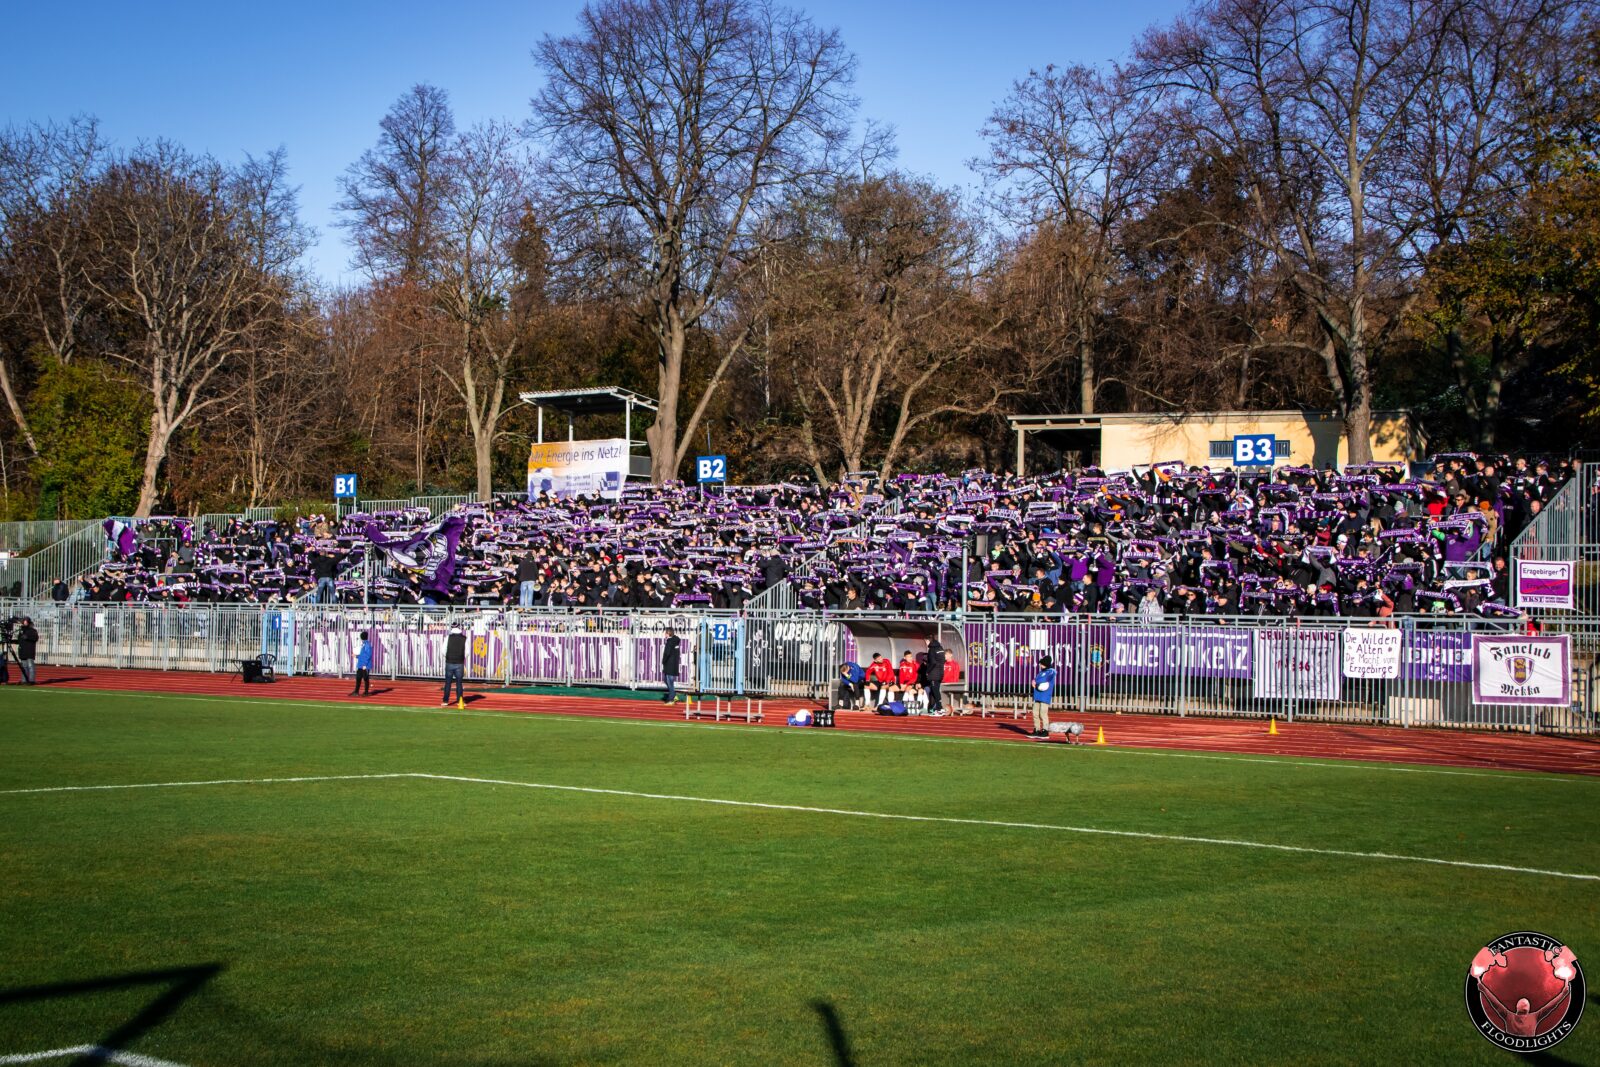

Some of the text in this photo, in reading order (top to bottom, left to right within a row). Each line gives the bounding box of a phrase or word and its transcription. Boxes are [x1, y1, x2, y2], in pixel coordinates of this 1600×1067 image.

[546, 449, 580, 466] Energie
[581, 447, 595, 461] ins
[597, 445, 622, 459] Netz!
[1236, 438, 1273, 462] B3
[699, 459, 724, 479] B2
[336, 477, 354, 494] B1
[1522, 567, 1559, 576] Erzgebirger
[718, 625, 725, 639] 2
[1345, 632, 1397, 645] Die Wilden
[1167, 640, 1248, 670] onkelz
[1356, 644, 1383, 655] Alten
[1490, 643, 1551, 662] Fanclub
[1349, 663, 1393, 678] Erzgebirge
[1501, 683, 1540, 696] Mekka
